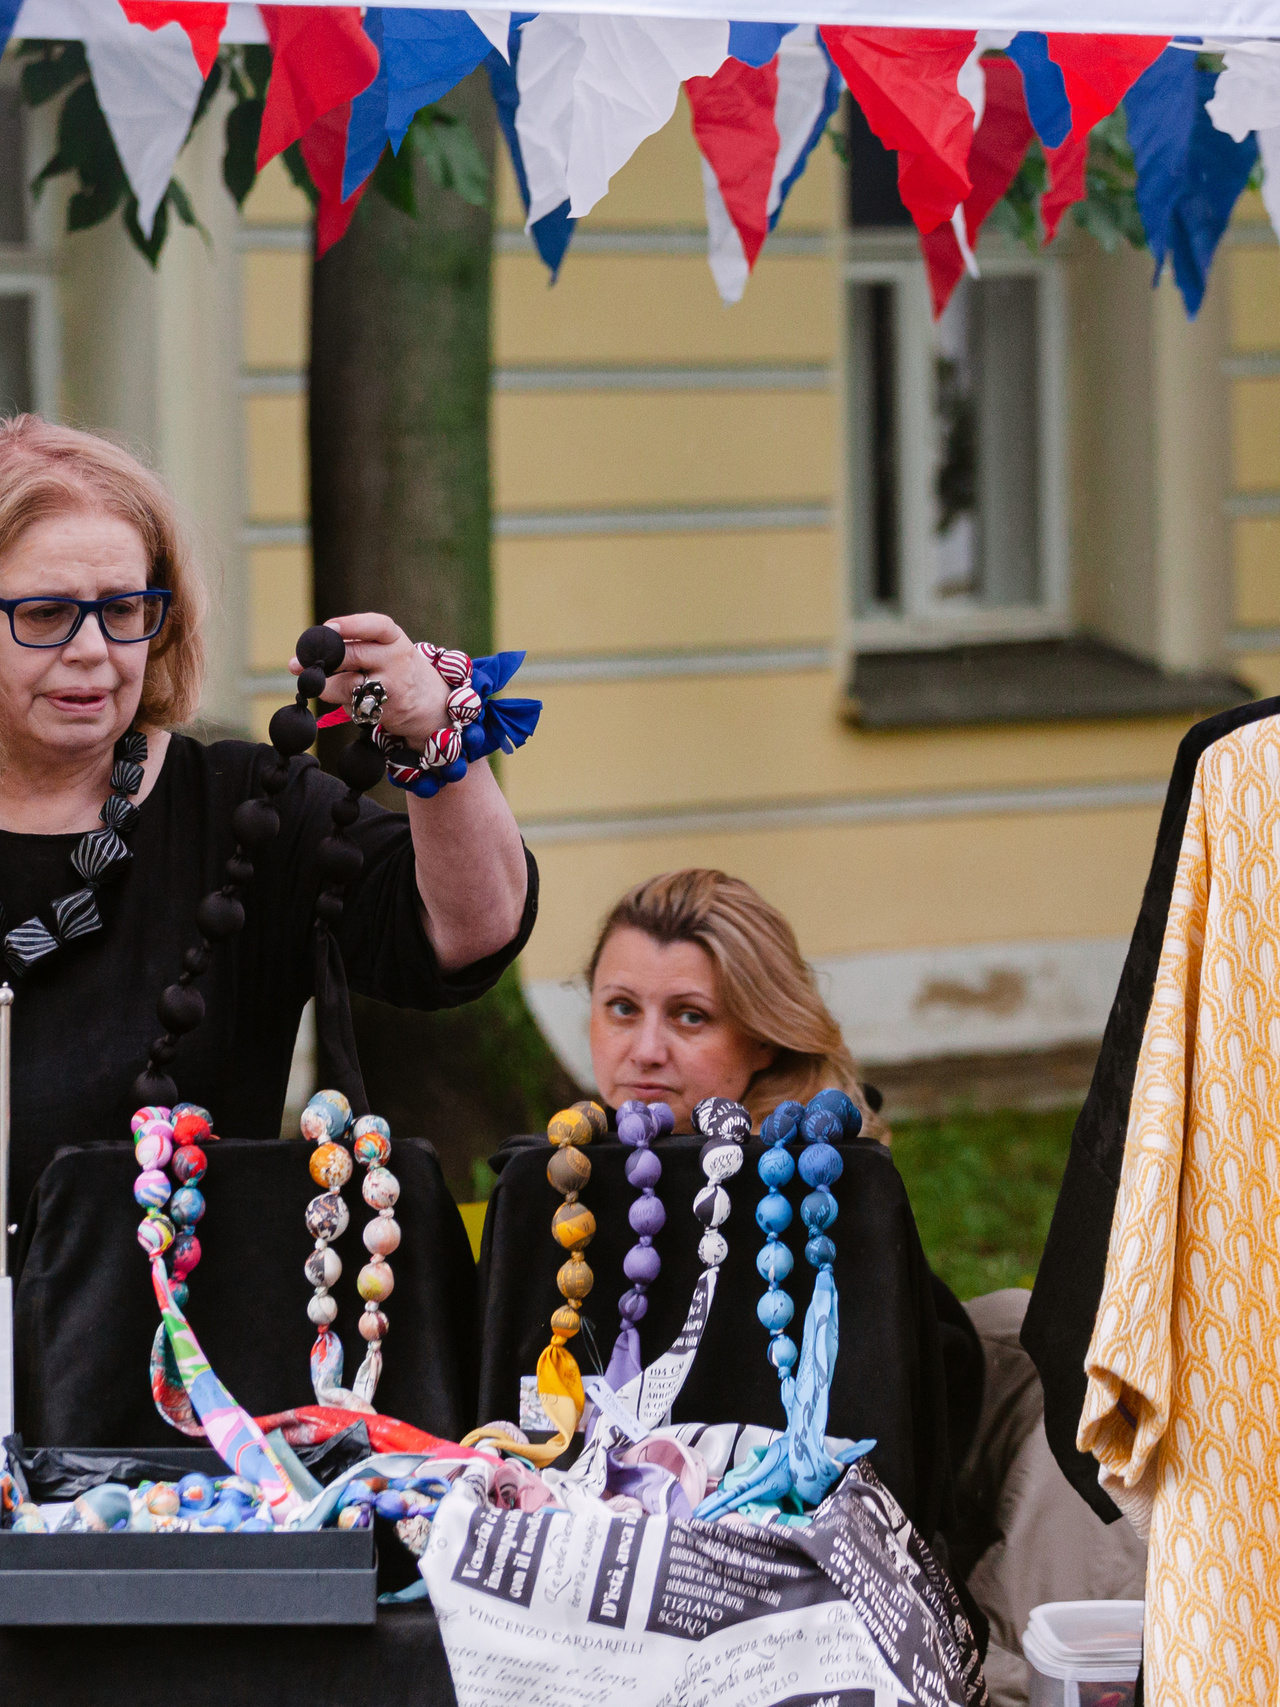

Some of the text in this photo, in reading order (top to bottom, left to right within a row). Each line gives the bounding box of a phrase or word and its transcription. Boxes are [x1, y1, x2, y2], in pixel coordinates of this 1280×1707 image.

[665, 1579, 713, 1601] abboccato
[669, 1562, 782, 1607] sembra che Venezia abbia
[662, 1594, 724, 1621] TIZIANO
[469, 1605, 644, 1655] VINCENZO CARDARELLI
[658, 1610, 708, 1636] SCARPA
[824, 1669, 894, 1691] GIOVANNI
